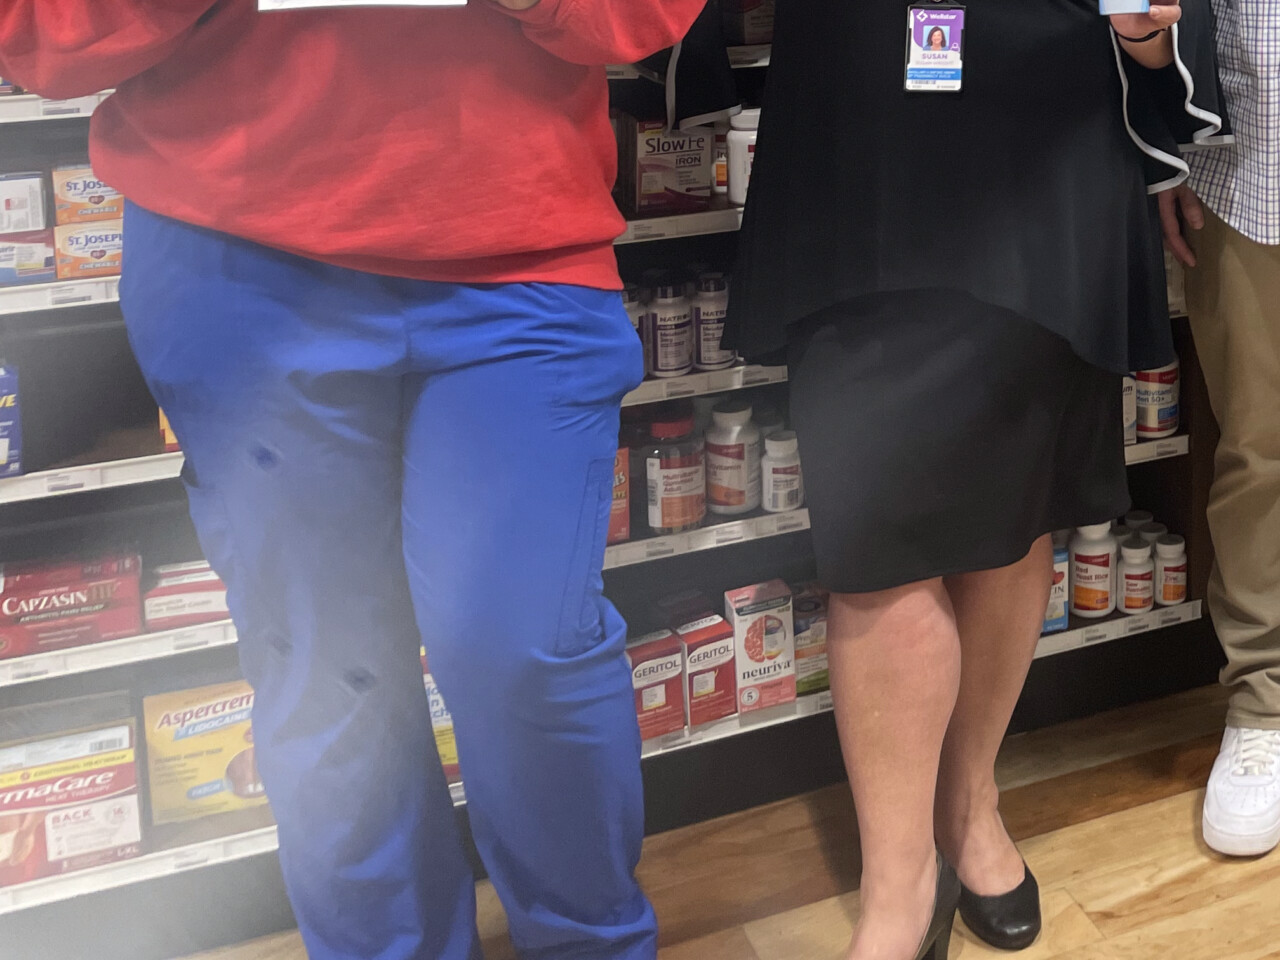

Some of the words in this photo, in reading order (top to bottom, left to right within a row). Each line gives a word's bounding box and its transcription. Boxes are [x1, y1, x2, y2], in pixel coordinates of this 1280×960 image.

[645, 137, 685, 154] Slow
[688, 136, 704, 149] Fe
[675, 155, 701, 165] IRON
[3, 591, 88, 616] CAPZASIN
[689, 645, 732, 664] GERITOL
[634, 661, 680, 679] GERITOL
[742, 659, 792, 680] neuriva
[745, 692, 754, 704] 5
[52, 808, 92, 824] BACK
